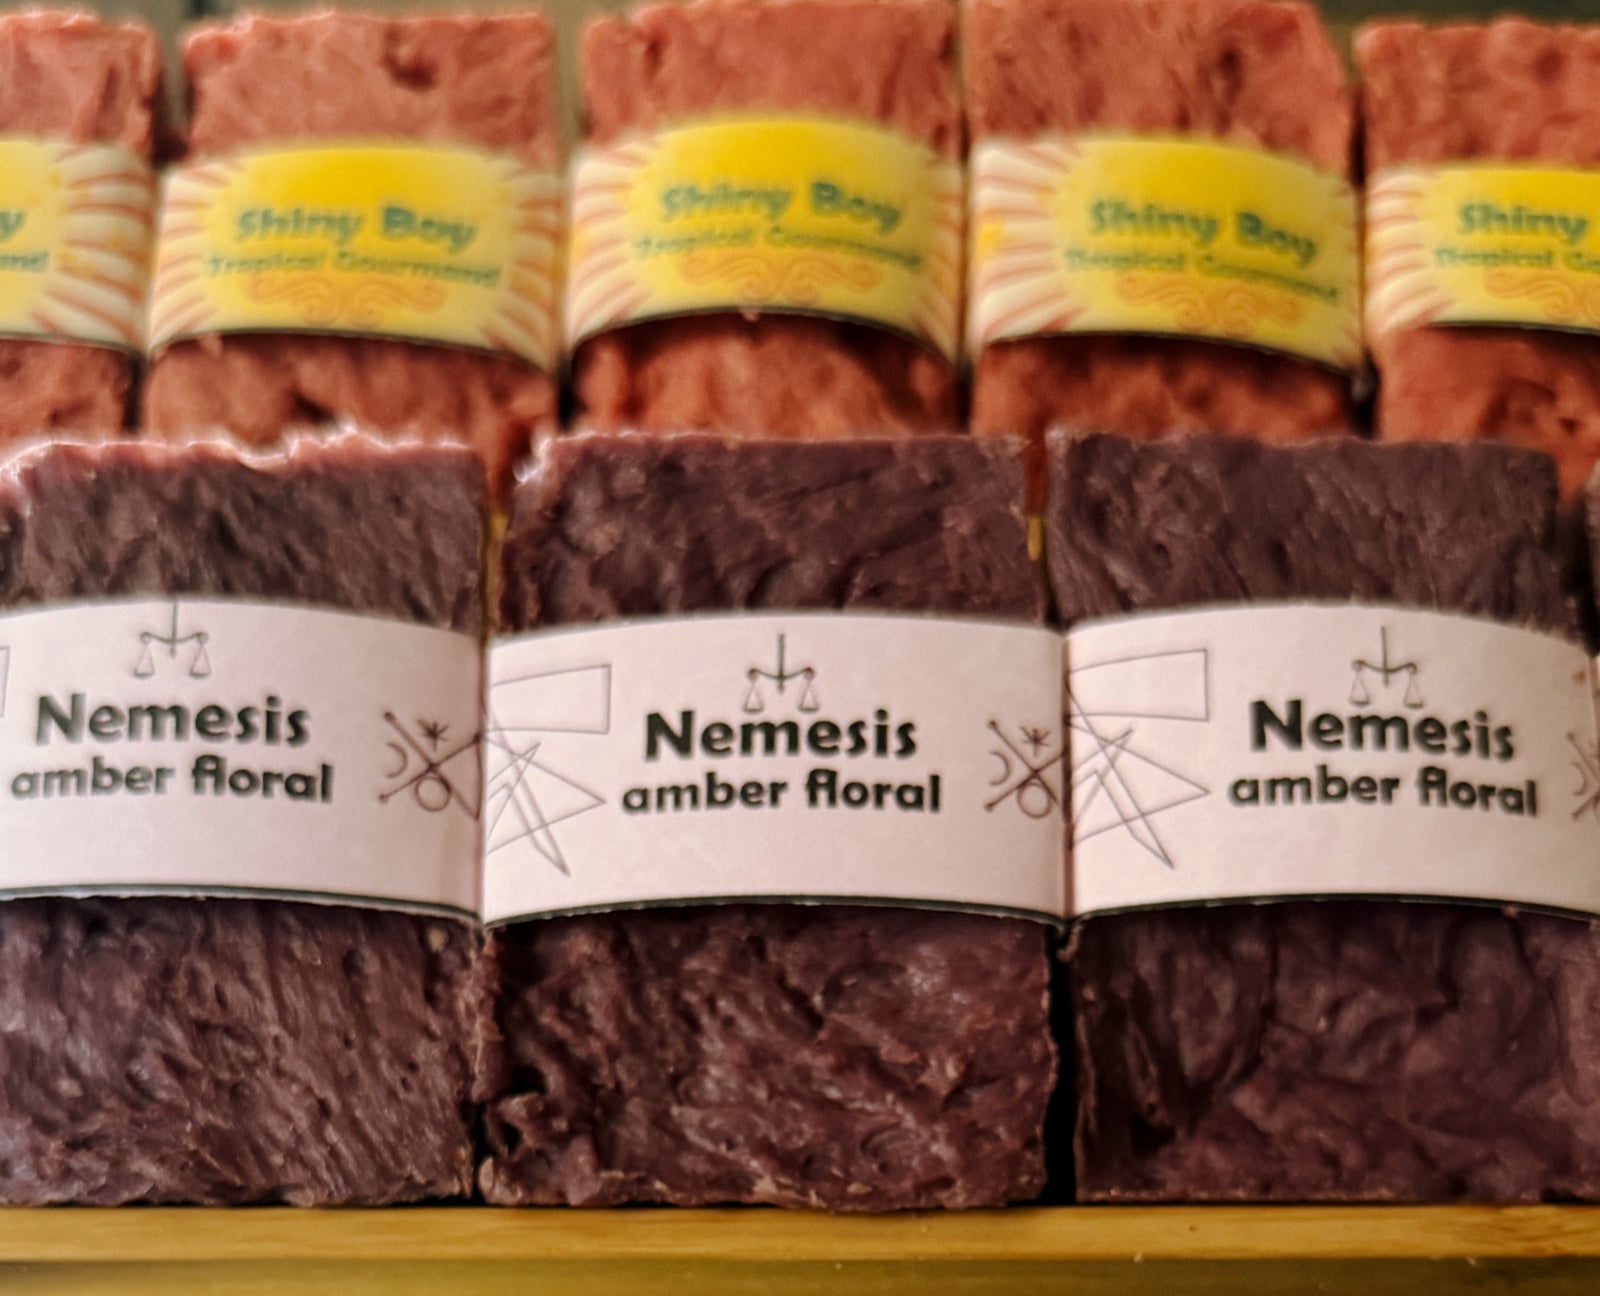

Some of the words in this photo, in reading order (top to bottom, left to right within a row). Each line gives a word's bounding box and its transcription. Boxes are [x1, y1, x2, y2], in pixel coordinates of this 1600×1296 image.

[236, 204, 363, 247] Shiny
[381, 204, 477, 256] Boy
[660, 182, 792, 224] Shiny
[811, 180, 902, 236] Boy
[1458, 202, 1588, 250] Shiny
[1090, 199, 1218, 250] Shiny
[1236, 208, 1317, 272] Boy
[35, 692, 312, 748] Nemesis
[644, 708, 918, 763] Nemesis
[1249, 699, 1515, 762] Nemesis
[10, 756, 175, 801] amber
[191, 754, 335, 804] floral
[622, 771, 787, 815] amber
[805, 768, 942, 814] floral
[1228, 765, 1400, 808] amber
[1415, 766, 1538, 817] floral
